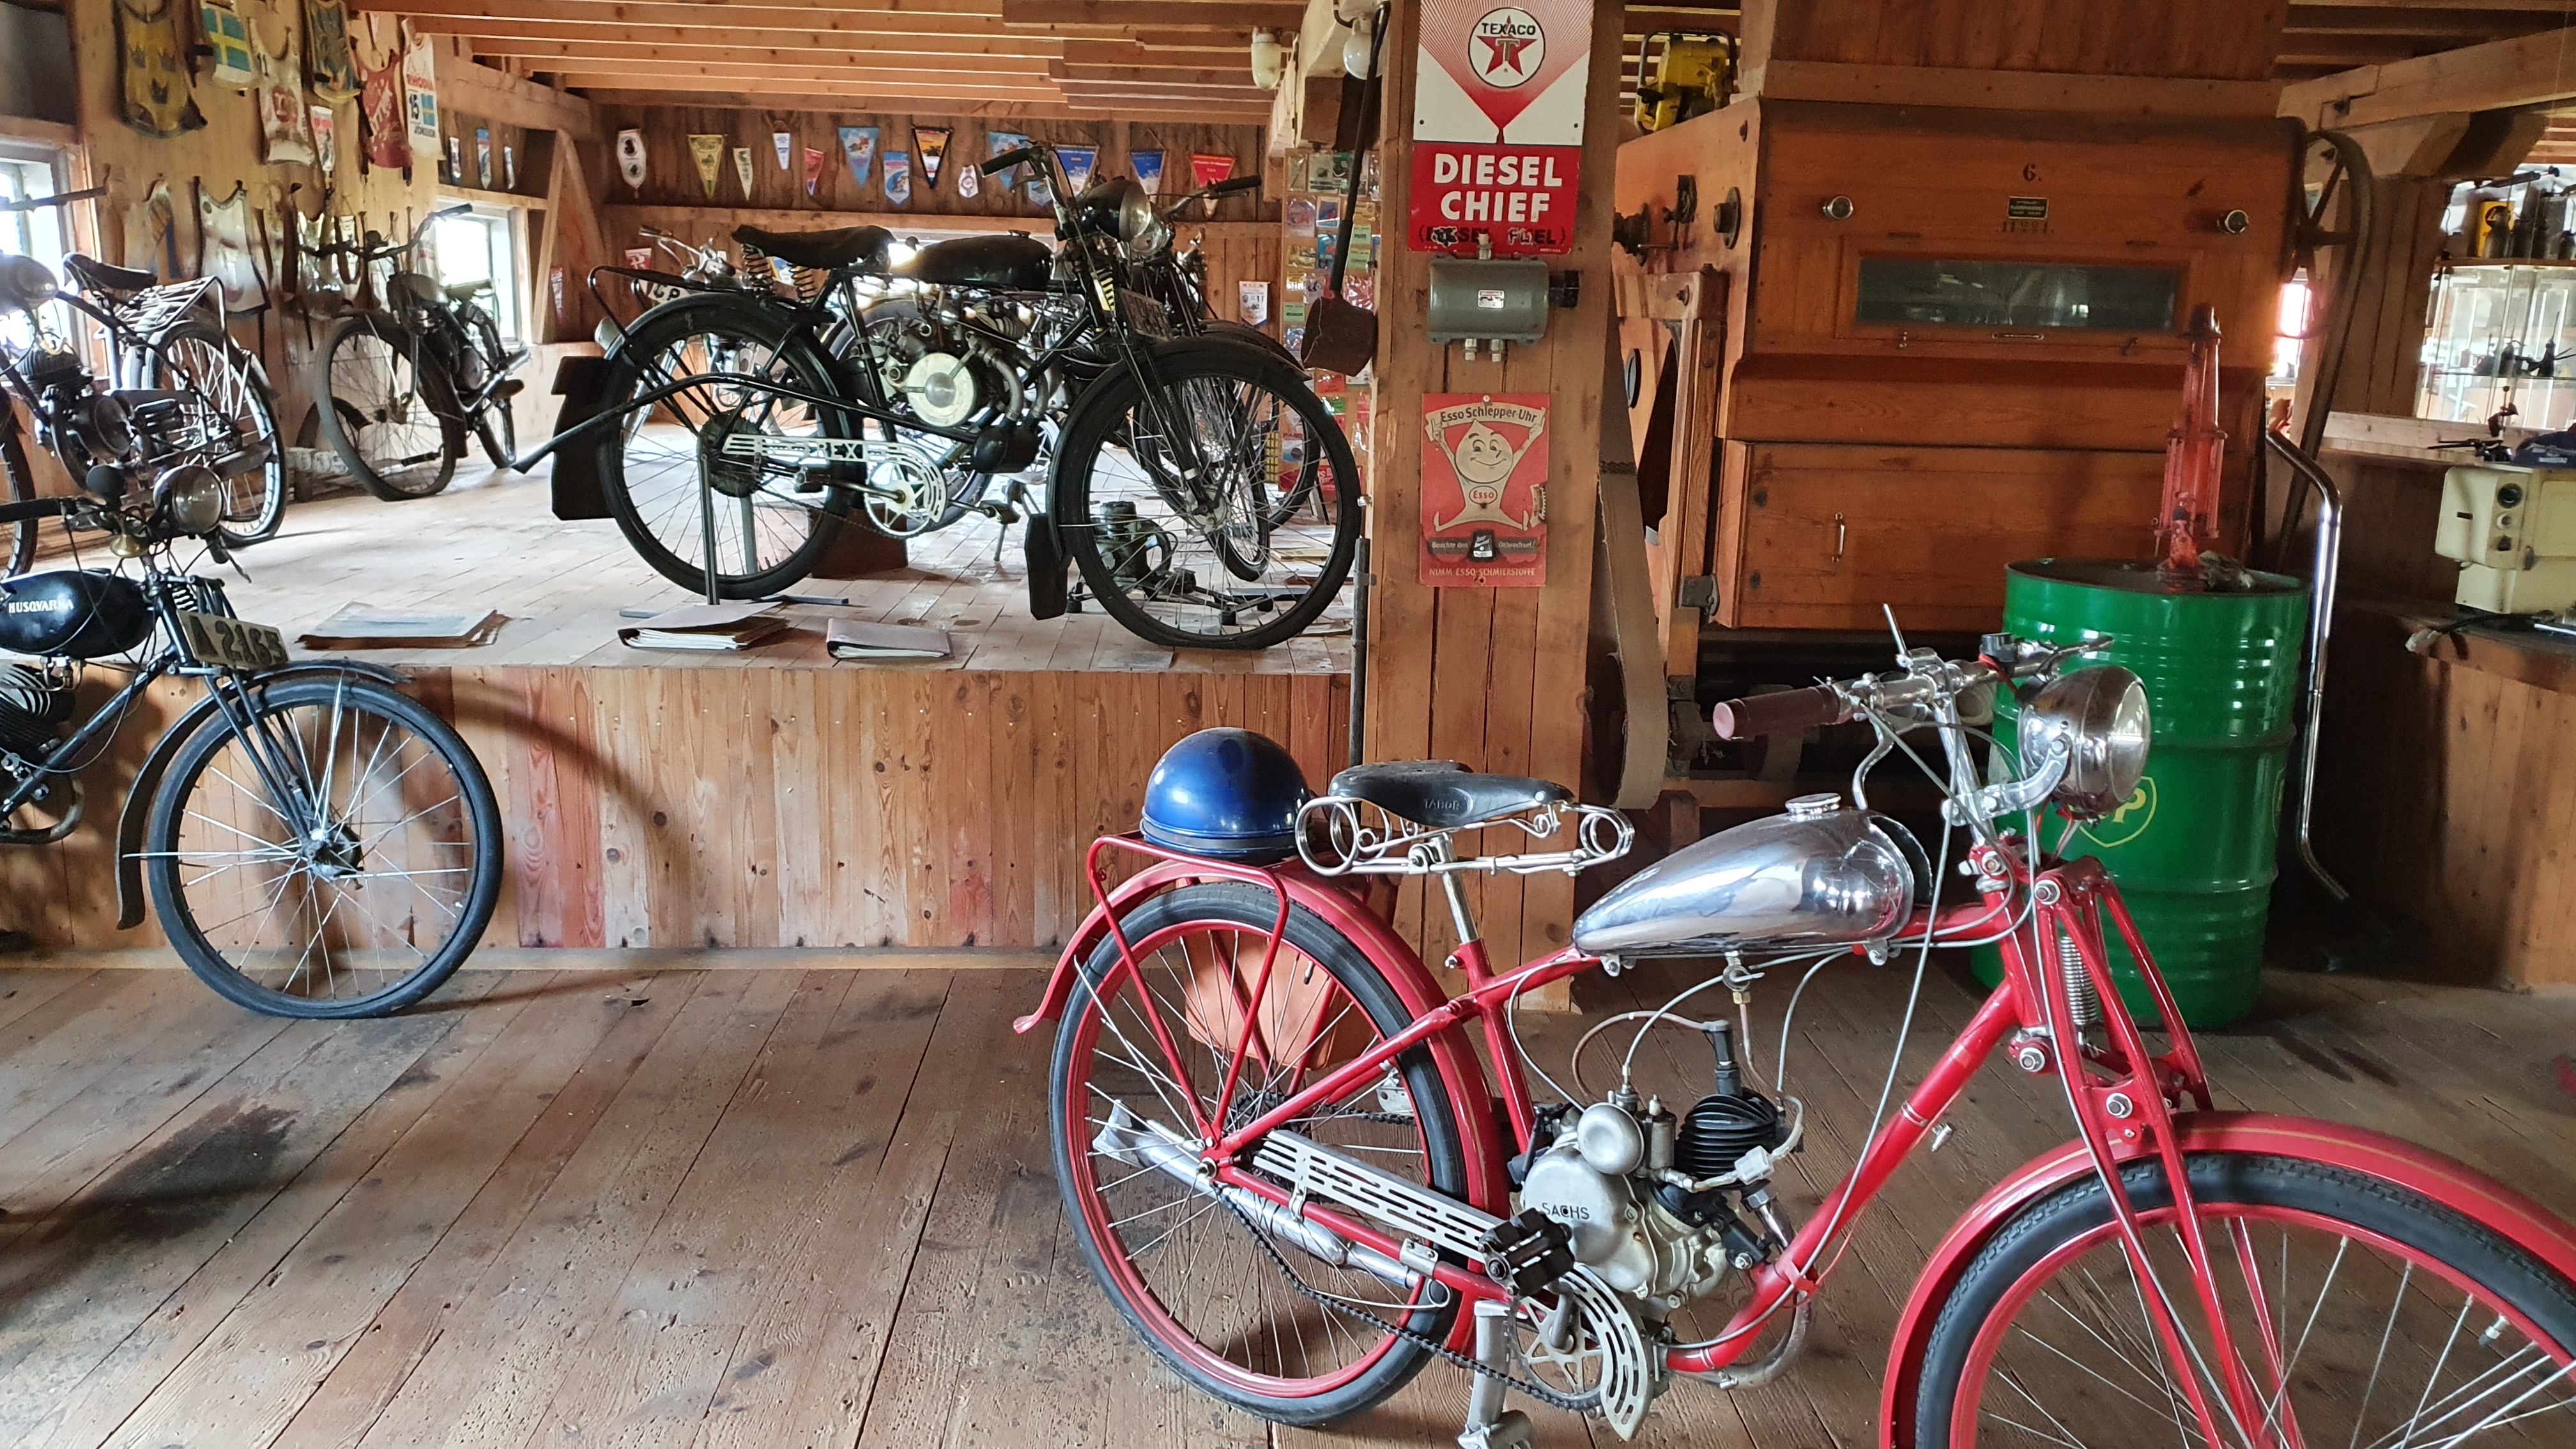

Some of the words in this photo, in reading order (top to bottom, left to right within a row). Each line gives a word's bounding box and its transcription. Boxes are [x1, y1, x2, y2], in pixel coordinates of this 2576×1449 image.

[1481, 22, 1536, 36] TEXACO
[1434, 153, 1563, 187] DIESEL
[1440, 190, 1550, 222] CHIEF
[1440, 411, 1464, 423] Esso
[1466, 406, 1537, 423] Schlepper-Uhr
[8, 599, 75, 614] HUSQVARNA
[1423, 797, 1461, 811] TABOR
[1541, 1202, 1590, 1220] SACHS
